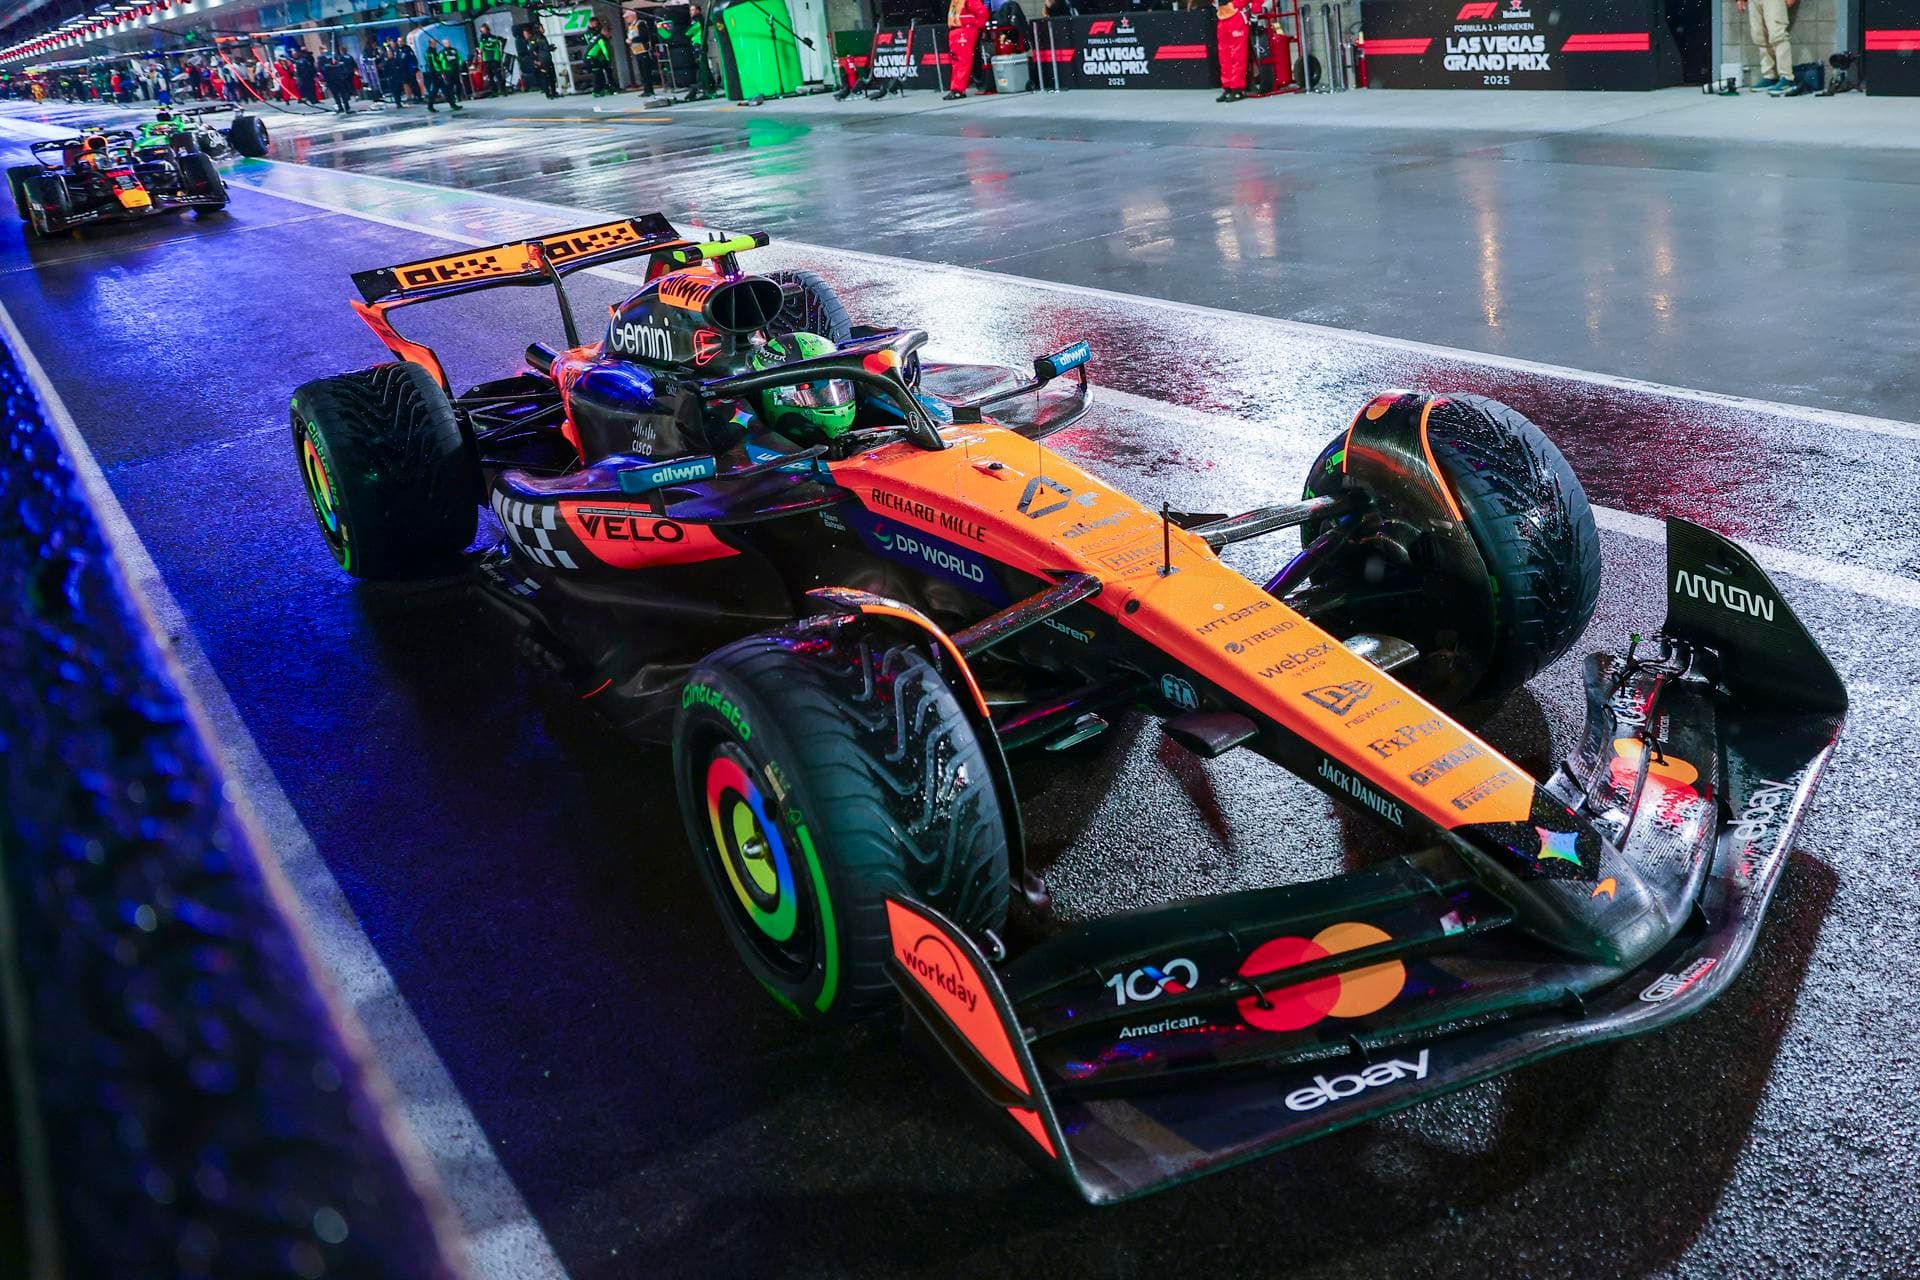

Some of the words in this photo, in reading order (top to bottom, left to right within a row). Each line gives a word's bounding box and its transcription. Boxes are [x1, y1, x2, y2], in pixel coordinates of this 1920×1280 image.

[563, 9, 592, 30] 27
[1084, 48, 1106, 61] LAS
[1106, 47, 1144, 60] VEGAS
[1446, 36, 1481, 53] LAS
[1482, 35, 1545, 53] VEGAS
[1083, 62, 1121, 75] GRAND
[1122, 61, 1149, 74] PRIX
[1444, 54, 1505, 71] GRAND
[1507, 54, 1550, 70] PRIX
[1483, 76, 1510, 85] 2025
[610, 309, 673, 361] Gemini
[652, 463, 706, 483] allwyn
[577, 514, 684, 543] VELO
[871, 488, 934, 523] RICHARD
[940, 513, 987, 543] MILLE
[895, 534, 919, 555] DP
[919, 543, 985, 583] WORLD
[1675, 569, 1774, 622] ARROW
[1258, 642, 1335, 679] webex
[1318, 757, 1350, 794] JACK
[1352, 777, 1404, 828] DANIEL'S
[903, 949, 977, 1012] workday
[1119, 1015, 1200, 1039] American
[1285, 1049, 1430, 1111] ebay
